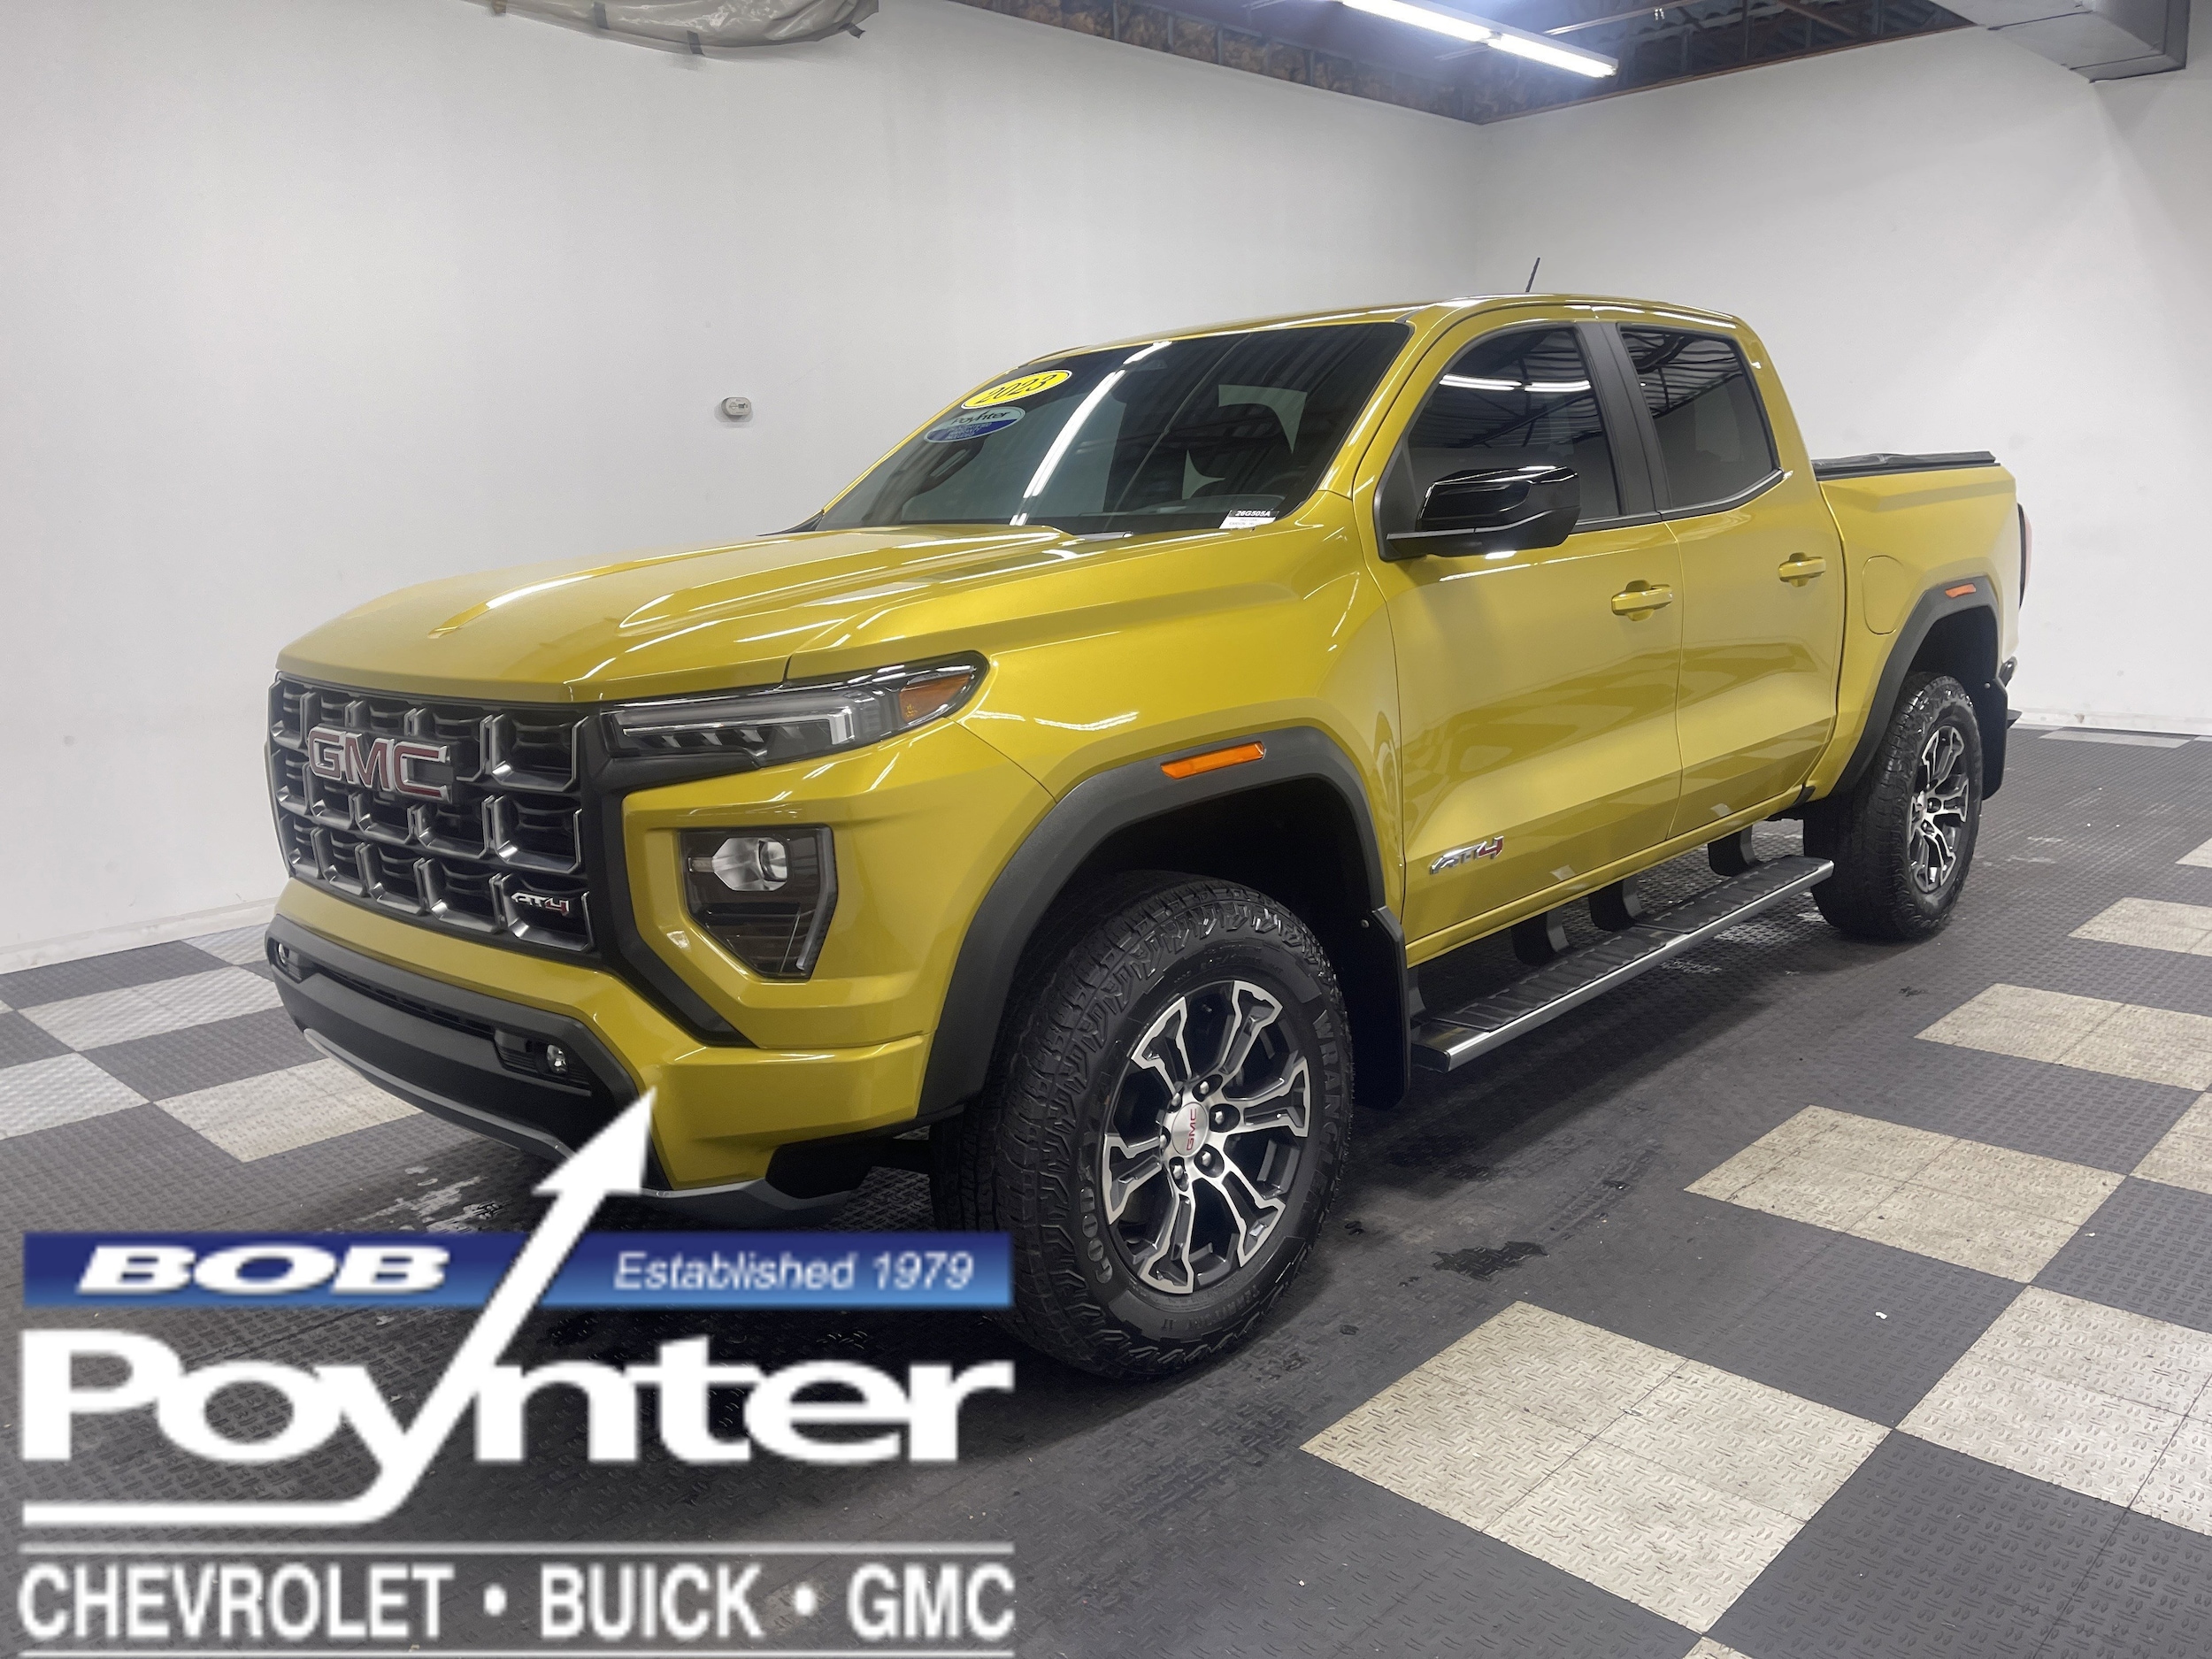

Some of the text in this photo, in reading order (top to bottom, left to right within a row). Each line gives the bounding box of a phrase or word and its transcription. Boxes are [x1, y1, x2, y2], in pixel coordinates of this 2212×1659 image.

[973, 374, 1058, 404] 2023
[950, 410, 1010, 425] Poynter
[309, 726, 453, 803] GMC
[511, 891, 570, 917] AT4
[1186, 1108, 1197, 1151] GMC
